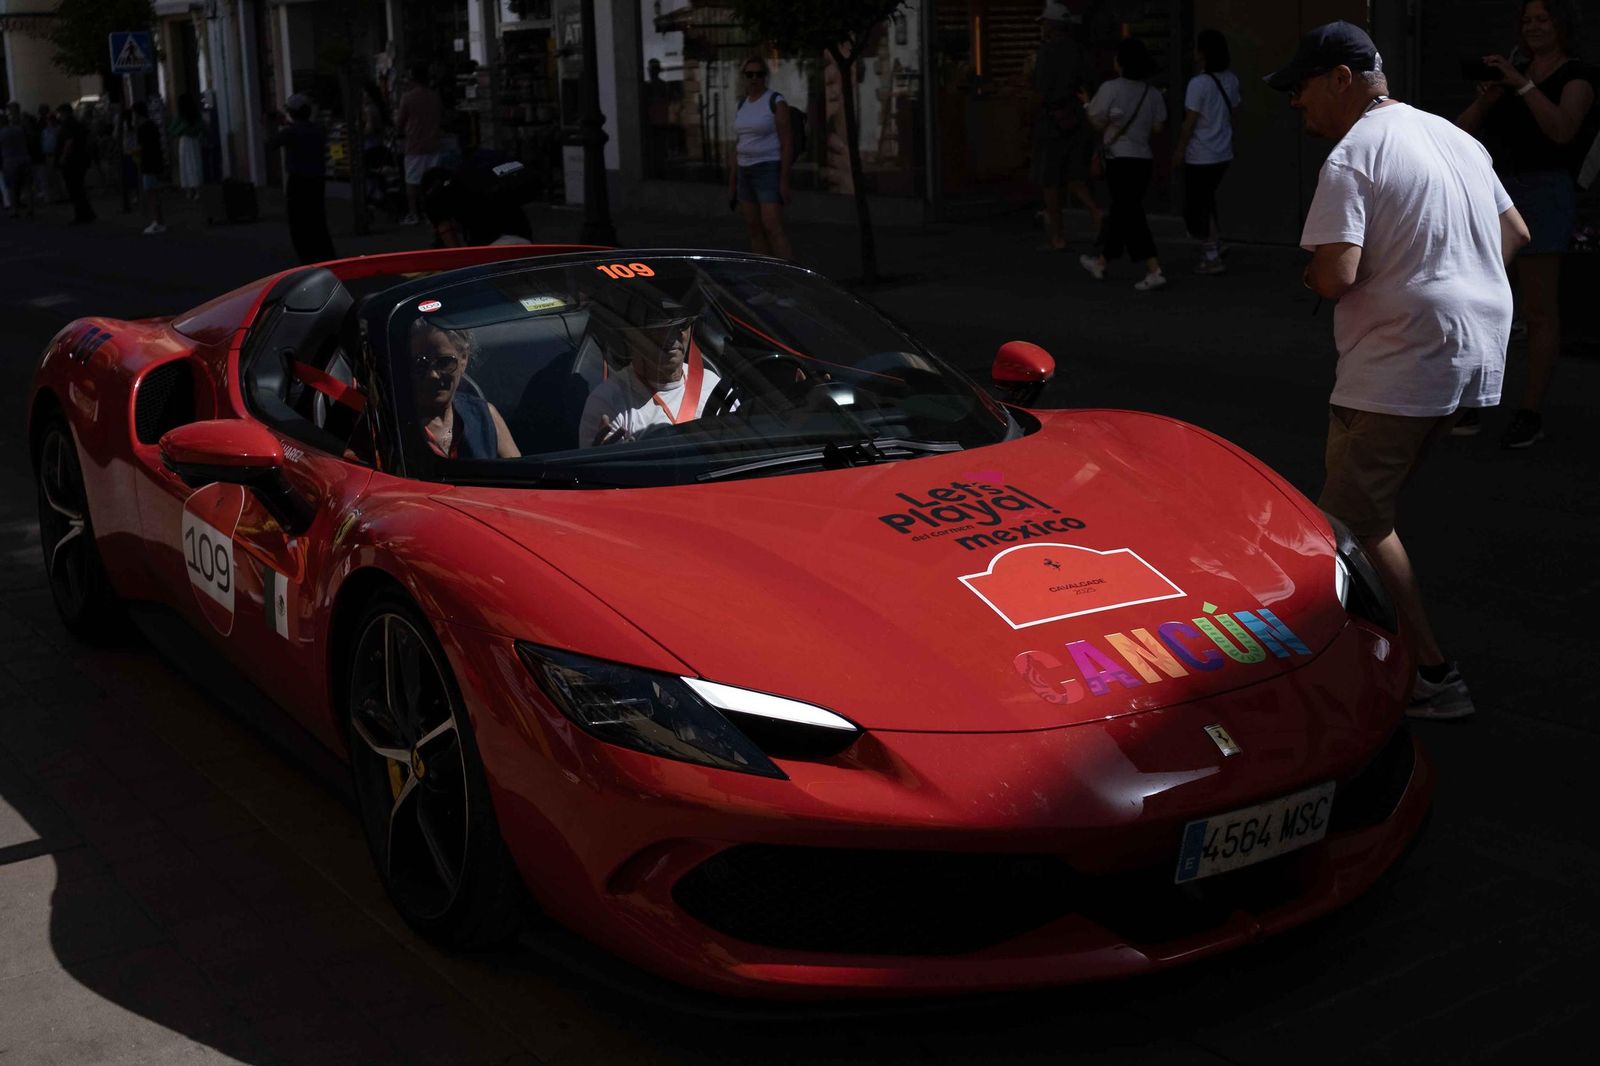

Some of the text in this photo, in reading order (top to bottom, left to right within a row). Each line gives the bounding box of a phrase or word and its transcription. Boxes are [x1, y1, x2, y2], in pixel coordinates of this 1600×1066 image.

[596, 262, 656, 281] 109
[896, 481, 1004, 508] Let's
[911, 533, 931, 542] del
[954, 517, 1086, 551] mexico
[185, 526, 230, 593] 109
[1048, 578, 1107, 593] CAVALCADE
[1013, 601, 1313, 706] CANCÚN
[1185, 797, 1329, 870] E 4564 MSC
